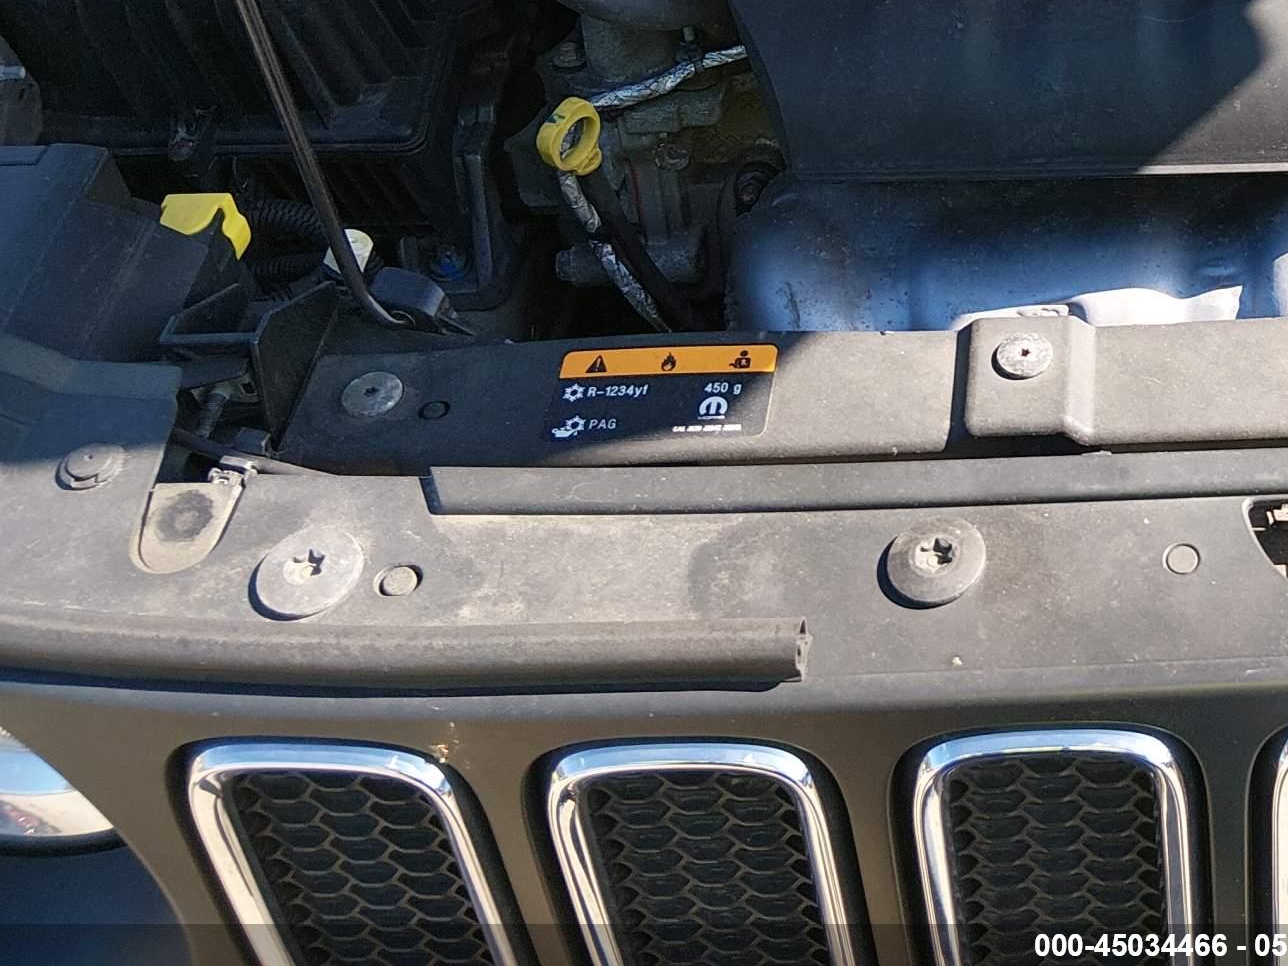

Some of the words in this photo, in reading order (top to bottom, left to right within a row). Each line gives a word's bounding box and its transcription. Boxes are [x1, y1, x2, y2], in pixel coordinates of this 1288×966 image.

[587, 383, 648, 398] R-1234yf
[704, 382, 729, 394] 450
[733, 383, 742, 395] g
[588, 418, 617, 430] PAG
